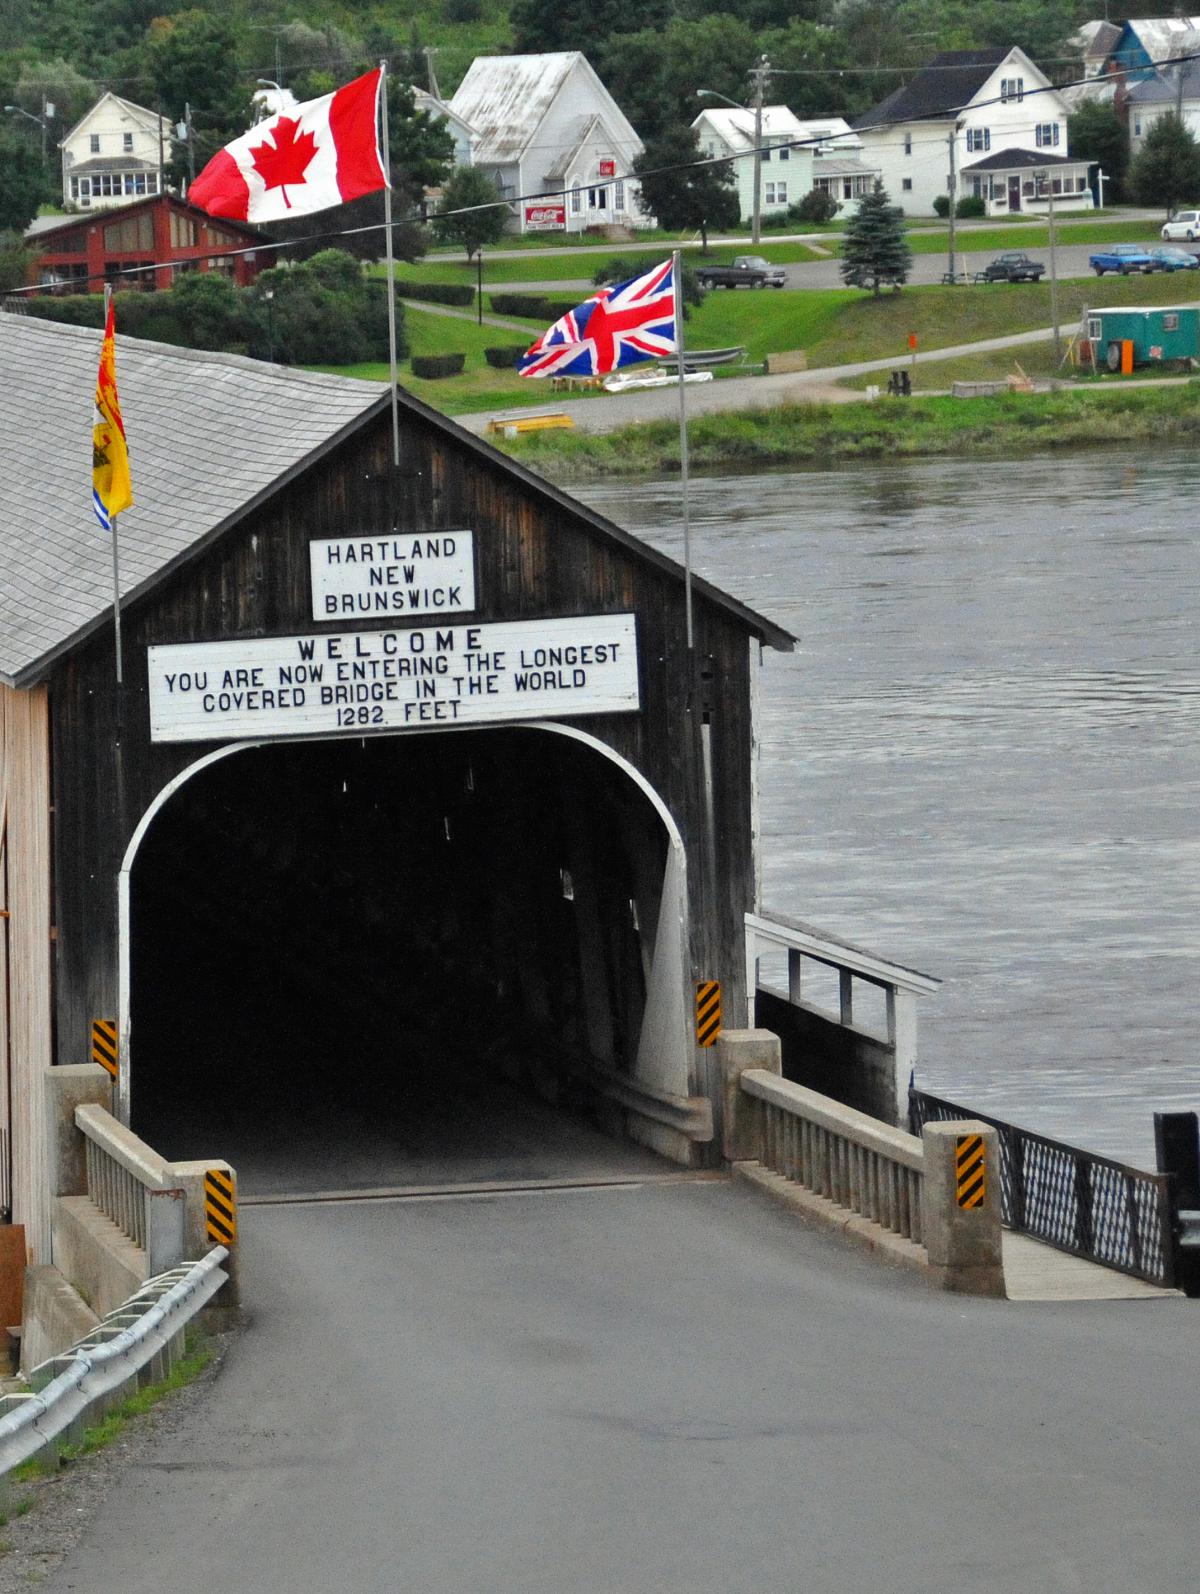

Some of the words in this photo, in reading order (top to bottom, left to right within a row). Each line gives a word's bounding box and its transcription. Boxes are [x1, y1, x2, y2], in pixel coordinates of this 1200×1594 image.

[327, 538, 456, 565] HARTLAND
[370, 565, 415, 586] NEW
[325, 586, 462, 614] BRUNSWICK
[298, 628, 481, 661] WELCOME
[164, 671, 207, 693] YOU
[222, 668, 264, 688] ARE
[279, 664, 323, 685] NOW
[337, 655, 449, 681] ENTERING
[464, 651, 506, 672] THE
[520, 643, 620, 669] LONGEST
[203, 687, 306, 712] COVERED
[320, 681, 398, 706] BRIDGE
[416, 679, 436, 698] IN
[453, 675, 499, 696] THE
[514, 669, 586, 692] WORLD
[405, 700, 461, 722] FEET
